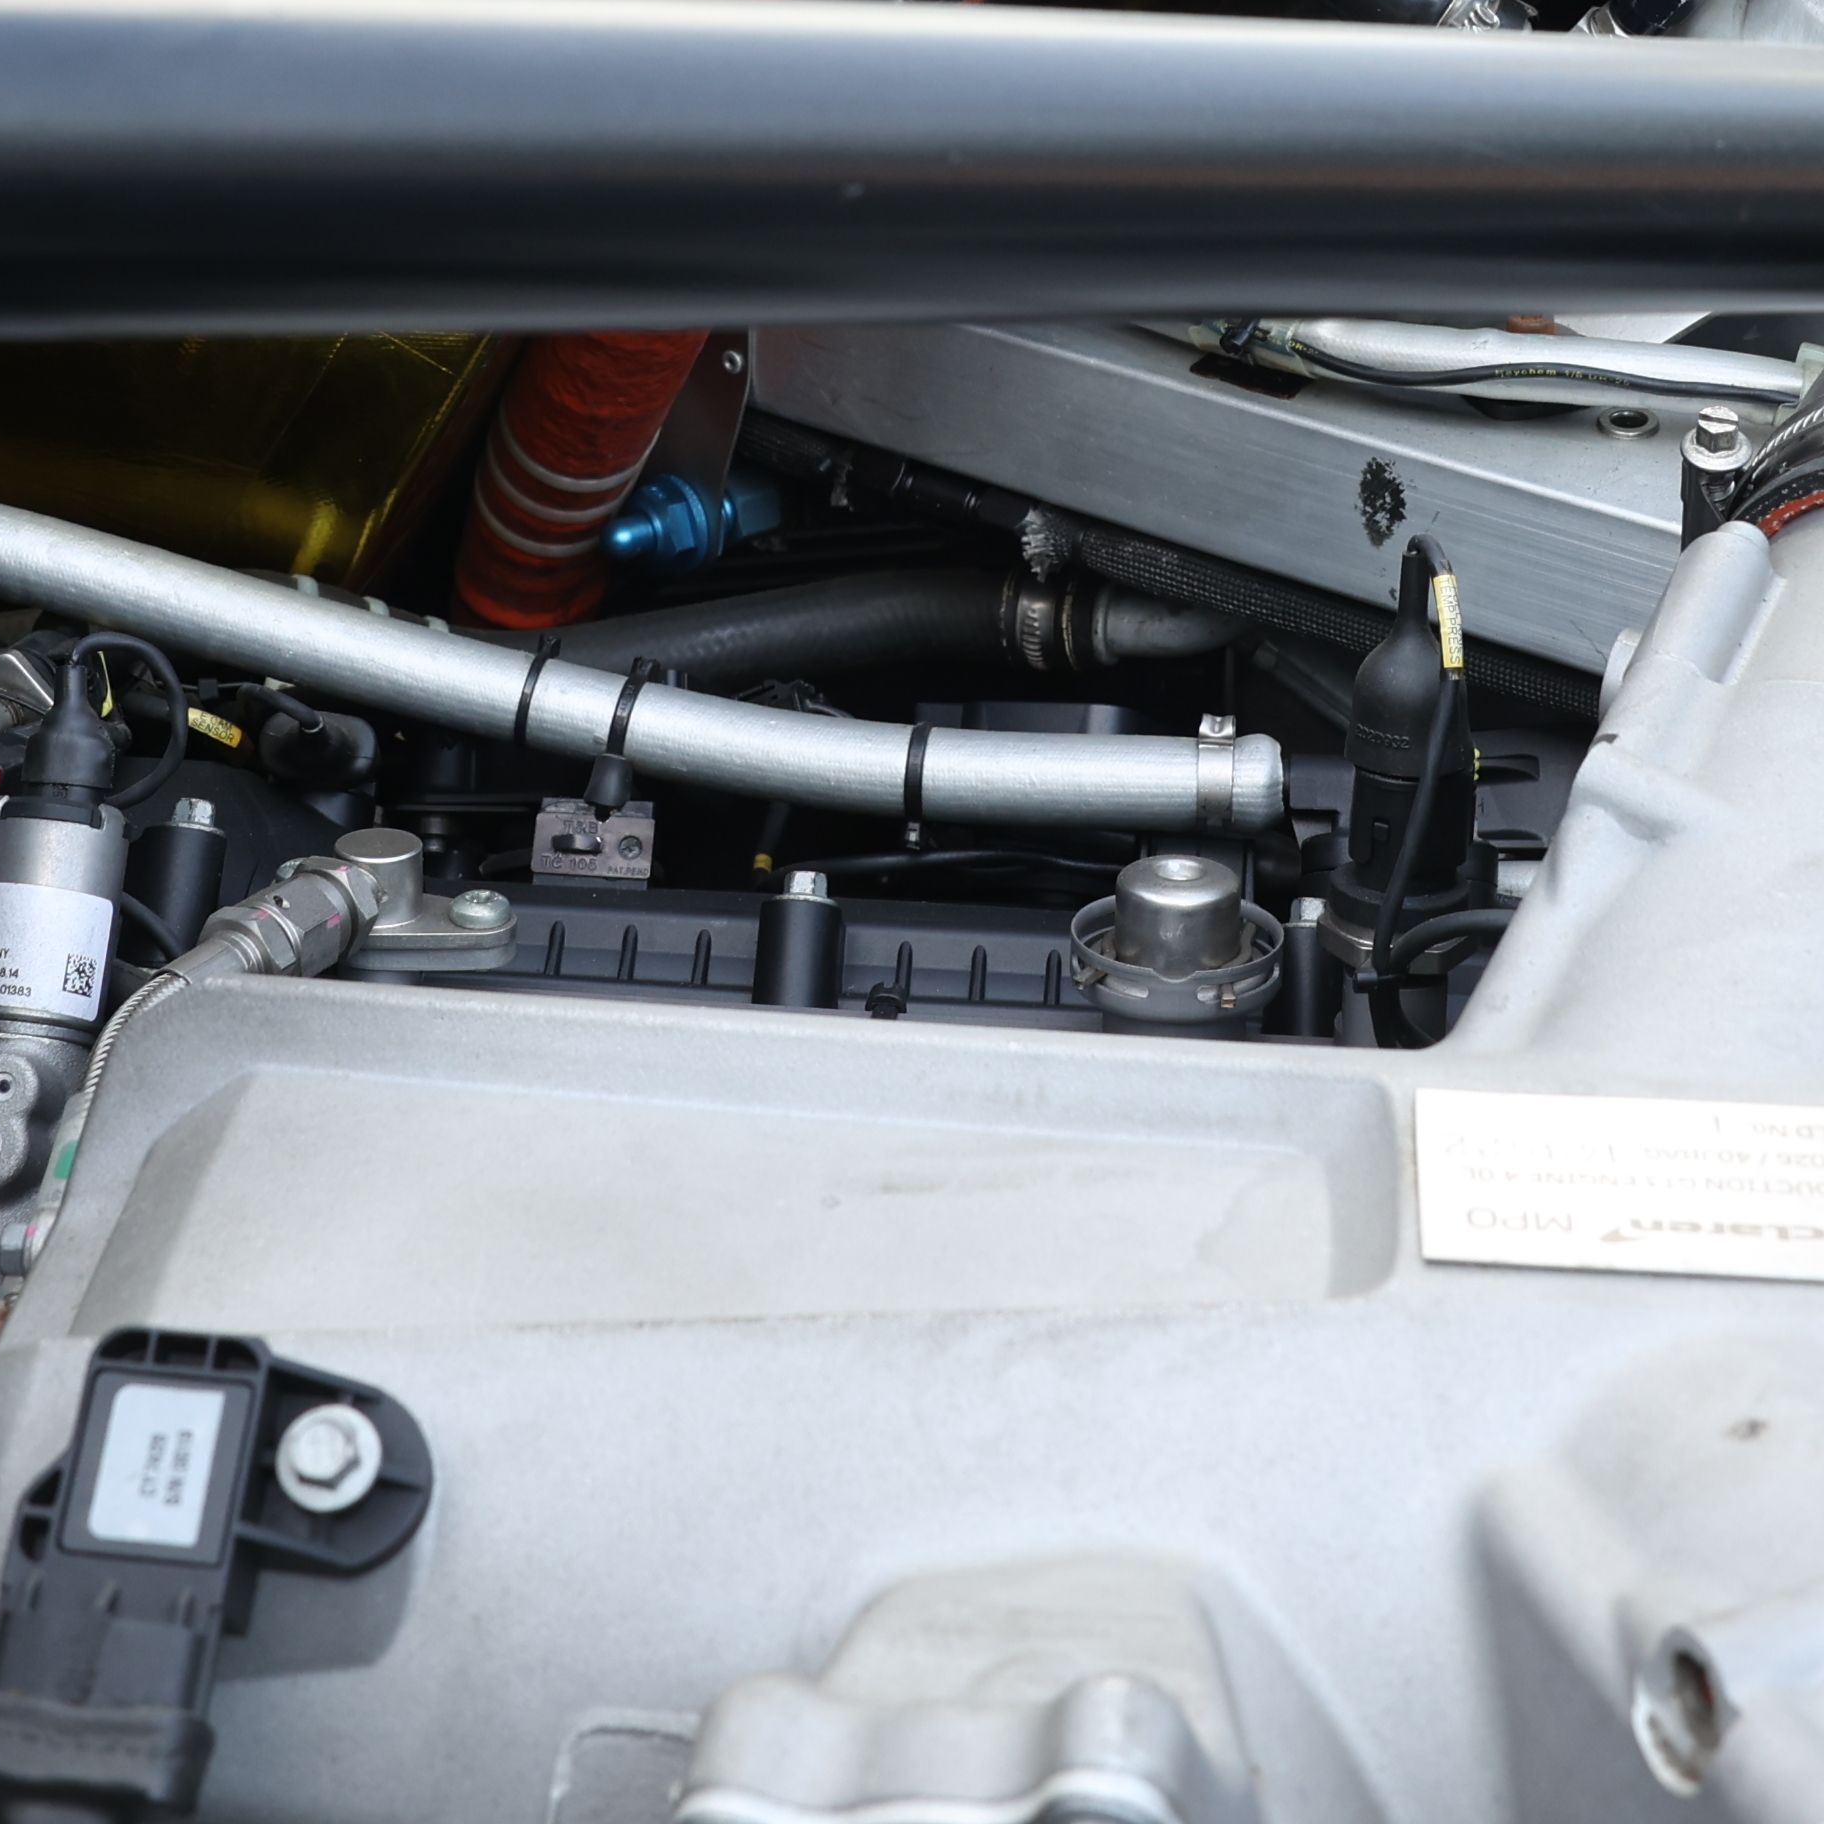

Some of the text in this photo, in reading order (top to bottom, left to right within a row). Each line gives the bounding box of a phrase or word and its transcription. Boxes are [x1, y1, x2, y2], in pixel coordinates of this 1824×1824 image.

[1439, 579, 1462, 665] TEMP PRESS
[191, 718, 234, 743] SENSOR
[569, 857, 598, 871] 105
[0, 984, 32, 997] 01383
